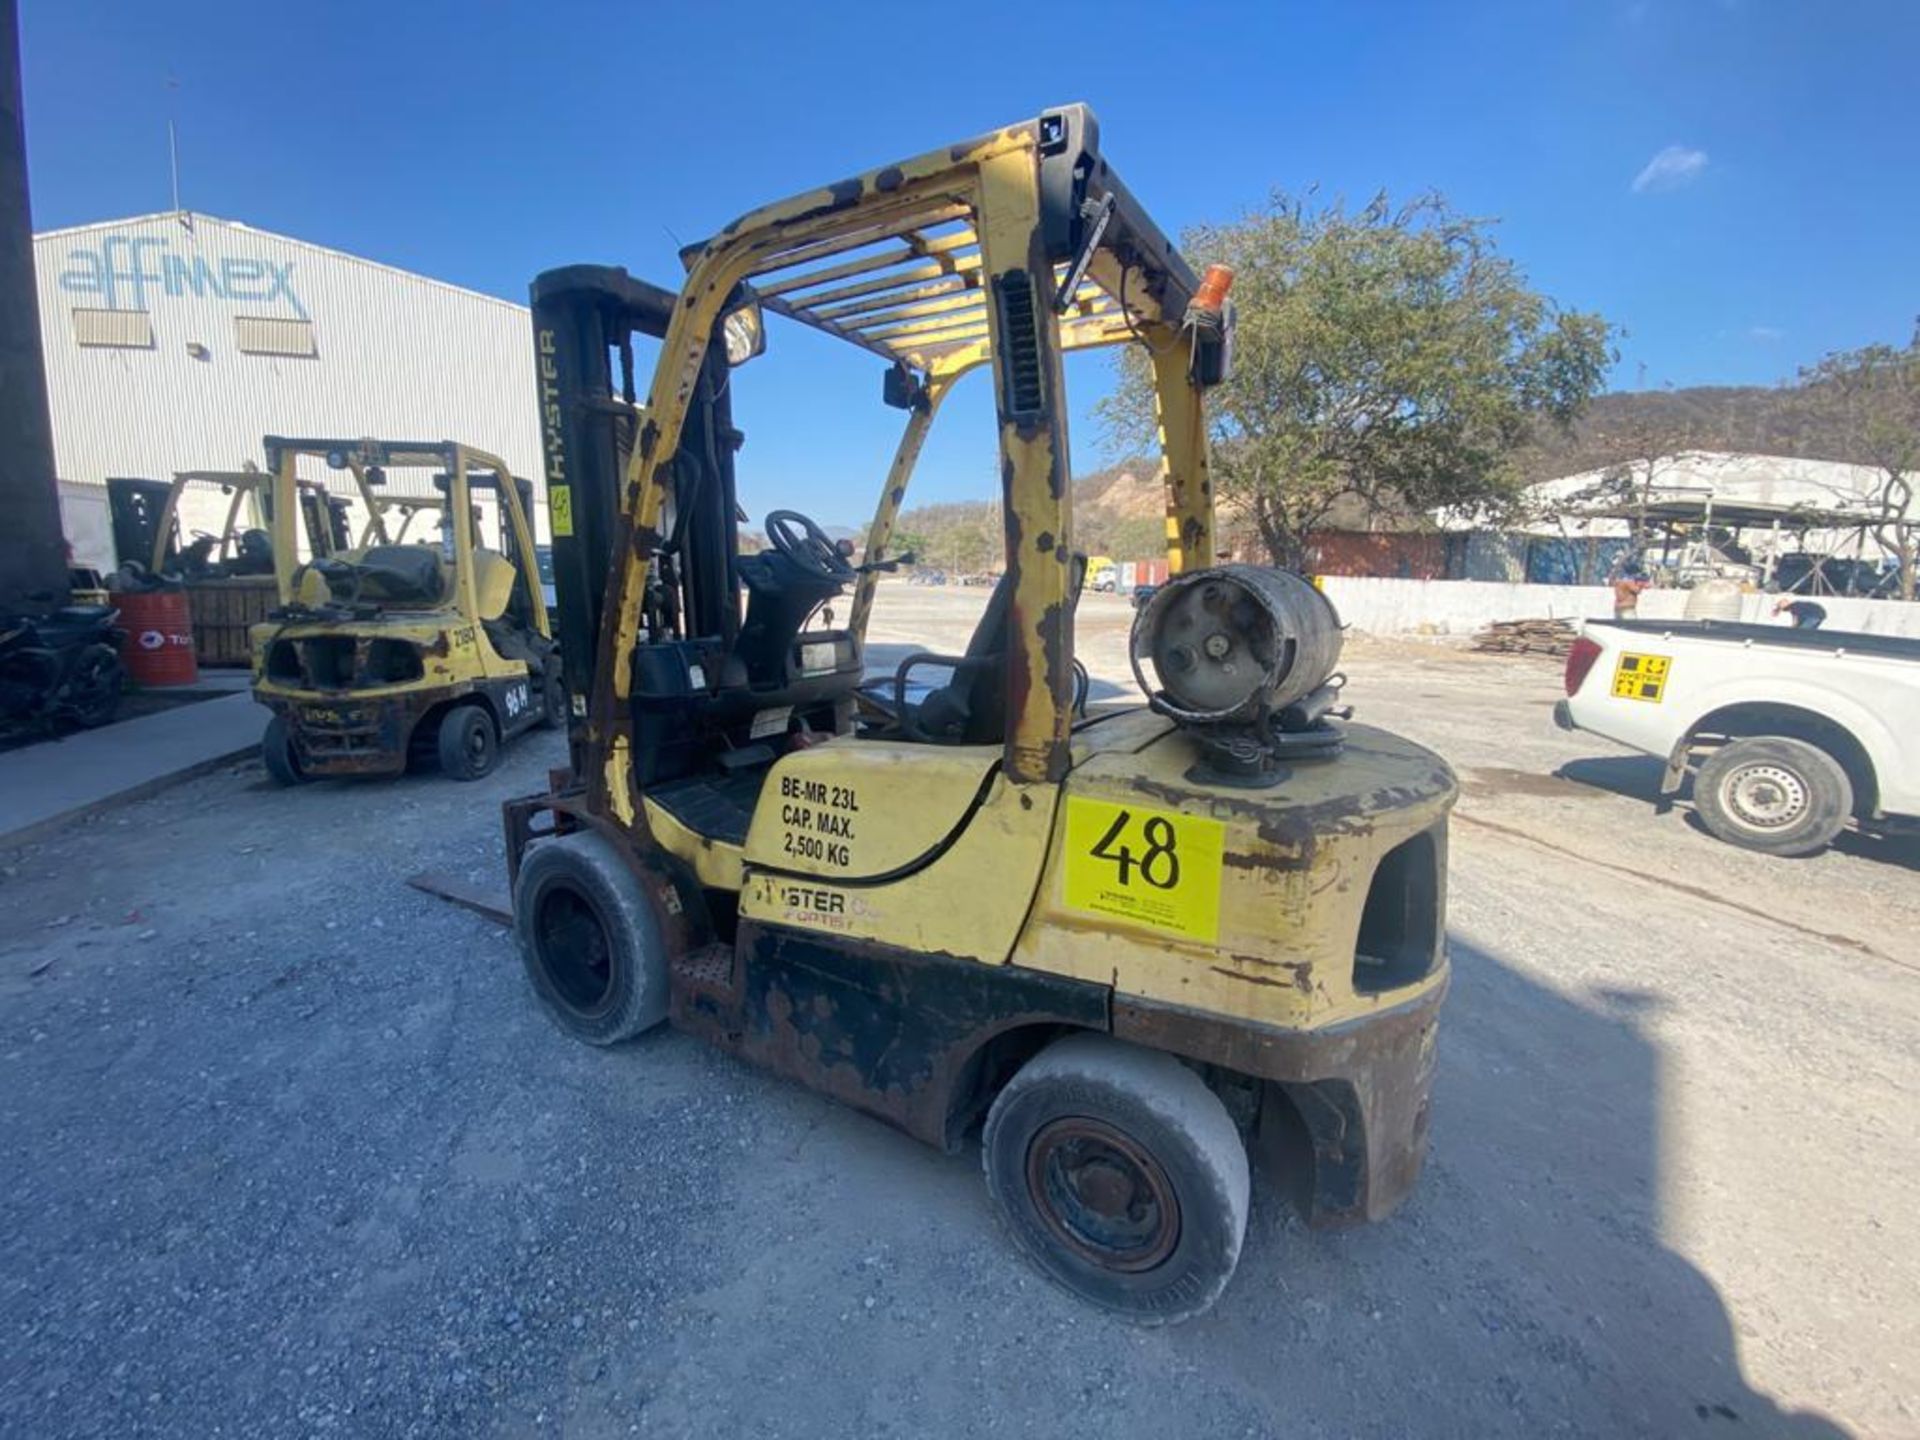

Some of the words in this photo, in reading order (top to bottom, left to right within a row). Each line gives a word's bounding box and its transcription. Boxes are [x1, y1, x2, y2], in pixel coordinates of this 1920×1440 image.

[540, 329, 566, 480] HYSTER
[506, 688, 519, 718] 96
[782, 776, 827, 806] BE-MR
[831, 786, 858, 813] 23L
[782, 804, 813, 830] CAP.
[817, 811, 855, 840] MAX.
[784, 831, 823, 860] 2,500
[827, 842, 850, 867] KG
[1090, 810, 1180, 890] 48
